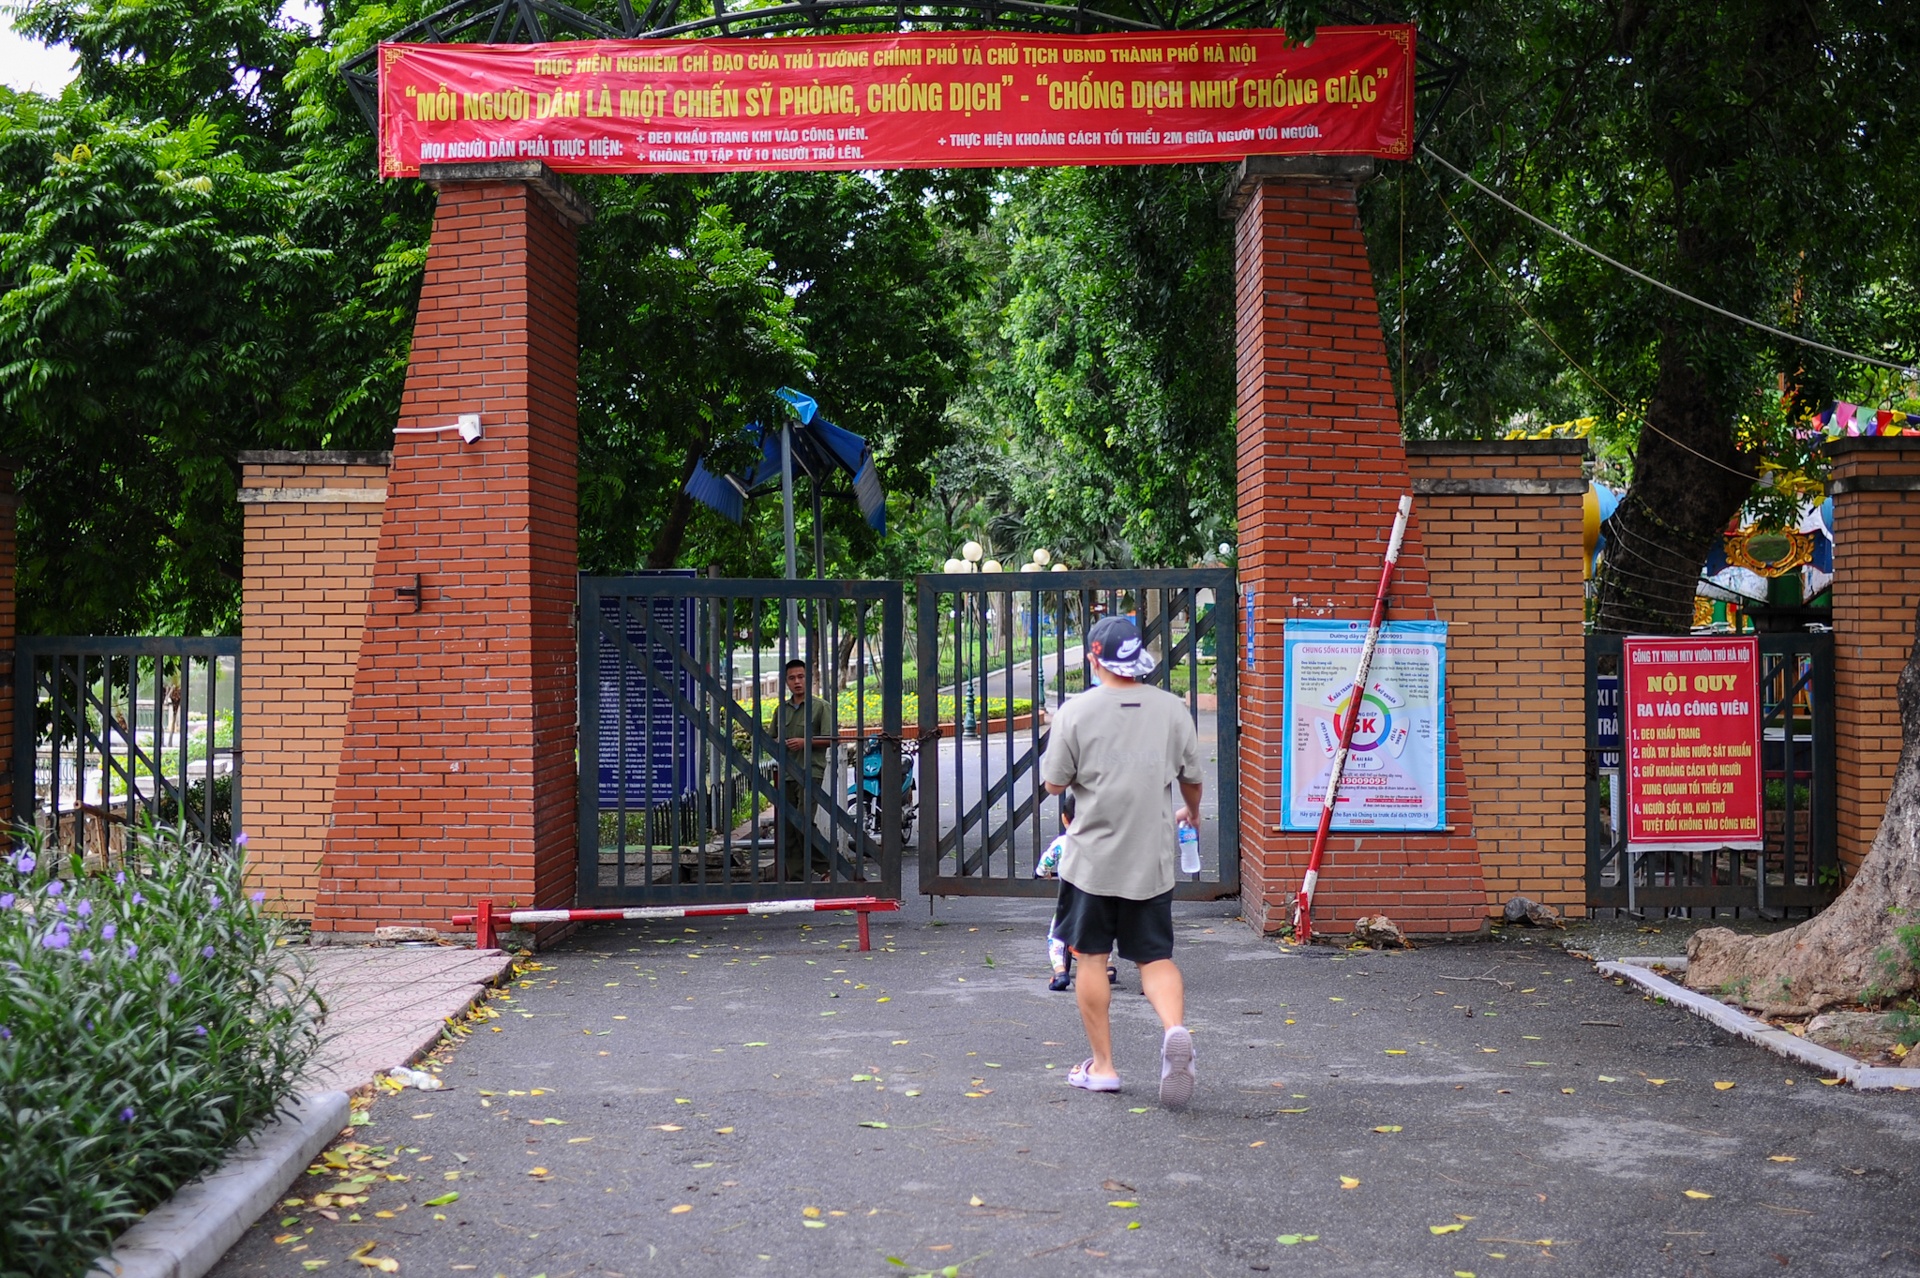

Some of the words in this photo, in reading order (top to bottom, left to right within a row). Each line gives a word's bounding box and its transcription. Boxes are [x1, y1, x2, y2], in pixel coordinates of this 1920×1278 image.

[533, 59, 573, 78] THỰC
[576, 54, 612, 76] HIỆN
[616, 53, 678, 73] NGHIÊM
[682, 50, 708, 73] CHỈ
[712, 54, 744, 74] ĐẠO
[748, 50, 779, 71] CỦA
[784, 48, 813, 69] THỦ
[817, 49, 868, 68] TƯỚNG
[873, 46, 922, 66] CHÍNH
[926, 43, 958, 65] PHỦ
[962, 45, 983, 65] VÀ
[987, 42, 1019, 65] CHỦ
[1023, 47, 1059, 67] TỊCH
[1063, 48, 1106, 63] UBND
[1110, 45, 1163, 63] THÀNH
[1167, 42, 1199, 62] PHỐ
[1203, 42, 1225, 62] HÀ
[1229, 42, 1257, 66] NỘI
[405, 82, 457, 121] “MỖI
[463, 86, 530, 121] NGƯỜI
[536, 86, 580, 120] DÂN
[586, 83, 613, 118] LÀ
[619, 83, 667, 124] MỘT
[673, 80, 739, 118] CHIẾN
[745, 81, 773, 117] SỸ
[779, 79, 861, 117] PHÒNG,
[867, 73, 942, 113] CHỐNG
[950, 74, 1014, 117] DỊCH”
[1036, 71, 1125, 110] “CHỐNG
[1132, 80, 1183, 115] DỊCH
[1189, 77, 1239, 109] NHƯ
[1243, 69, 1319, 108] CHỐNG
[1325, 67, 1388, 109] GIẶC”
[647, 131, 672, 144] ĐEO
[675, 127, 707, 144] KHẨU
[710, 130, 749, 144] TRANG
[752, 129, 772, 143] KHI
[775, 127, 799, 142] VÀO
[801, 127, 835, 142] CÔNG
[837, 125, 869, 141] VIÊN.
[949, 132, 981, 149] THỰC
[984, 130, 1013, 148] HIỆN
[1015, 129, 1065, 146] KHOẢNG
[1068, 129, 1101, 145] CÁCH
[1104, 128, 1123, 144] TỐI
[1126, 127, 1160, 144] THIỂU
[1163, 131, 1183, 144] 2M
[1185, 129, 1214, 144] GIỮA
[1217, 127, 1254, 142] NGƯỜI
[1258, 125, 1278, 140] VỚI
[1281, 123, 1322, 139] NGƯỜI.
[421, 142, 445, 162] MỌI
[449, 138, 486, 158] NGƯỜI
[489, 138, 517, 157] DÂN
[518, 135, 549, 157] PHẢI
[552, 138, 586, 159] THỰC
[589, 135, 624, 158] HIỆN:
[649, 146, 690, 162] KHÔNG
[693, 149, 709, 164] TỤ
[711, 145, 733, 164] TẬP
[737, 146, 753, 161] TỪ
[755, 148, 770, 161] 10
[772, 146, 809, 160] NGƯỜI
[812, 144, 835, 160] TRỞ
[837, 145, 865, 159] LÊN.
[1302, 646, 1323, 654] CHUNG
[1323, 645, 1339, 654] SỐNG
[1388, 647, 1402, 656] DỊCH
[1402, 647, 1429, 655] COVID-19
[1652, 650, 1660, 662] TY
[1661, 650, 1679, 662] TNHH
[1680, 650, 1694, 662] MTV
[1727, 647, 1737, 661] HÀ
[1738, 646, 1750, 663] NỘI
[1647, 672, 1687, 695] NỘI
[1694, 675, 1737, 693] QUY
[1637, 703, 1654, 717] RA
[1656, 700, 1681, 717] VÀO
[1684, 700, 1718, 716] CÔNG
[1720, 699, 1749, 715] VIÊN
[1632, 729, 1640, 740] 1.
[1641, 728, 1655, 740] ĐEO
[1656, 724, 1676, 740] KHẨU
[1677, 727, 1701, 739] TRANG
[1632, 747, 1640, 759] 2.
[1641, 744, 1656, 758] RỬA
[1657, 746, 1669, 758] TAY
[1670, 743, 1691, 758] BẰNG
[1713, 744, 1726, 757] SÁT
[1727, 741, 1752, 757] KHUẨN
[1633, 766, 1640, 777] 3.
[1655, 761, 1685, 777] KHOẢNG
[1686, 763, 1706, 776] CÁCH
[1719, 761, 1741, 776] NGƯỜI
[1641, 783, 1662, 795] XUNG
[1663, 783, 1688, 796] QUANH
[1722, 782, 1734, 794] 2M
[1634, 804, 1642, 815] 4.
[1642, 801, 1665, 815] NGƯỜI
[1696, 800, 1710, 814] KHÓ
[1712, 798, 1726, 814] THỞ
[1642, 817, 1664, 834] TUYỆT
[1679, 817, 1703, 831] KHÔNG
[1704, 816, 1718, 830] VÀO
[1719, 816, 1738, 830] CÔNG
[1740, 816, 1757, 830] VIÊN
